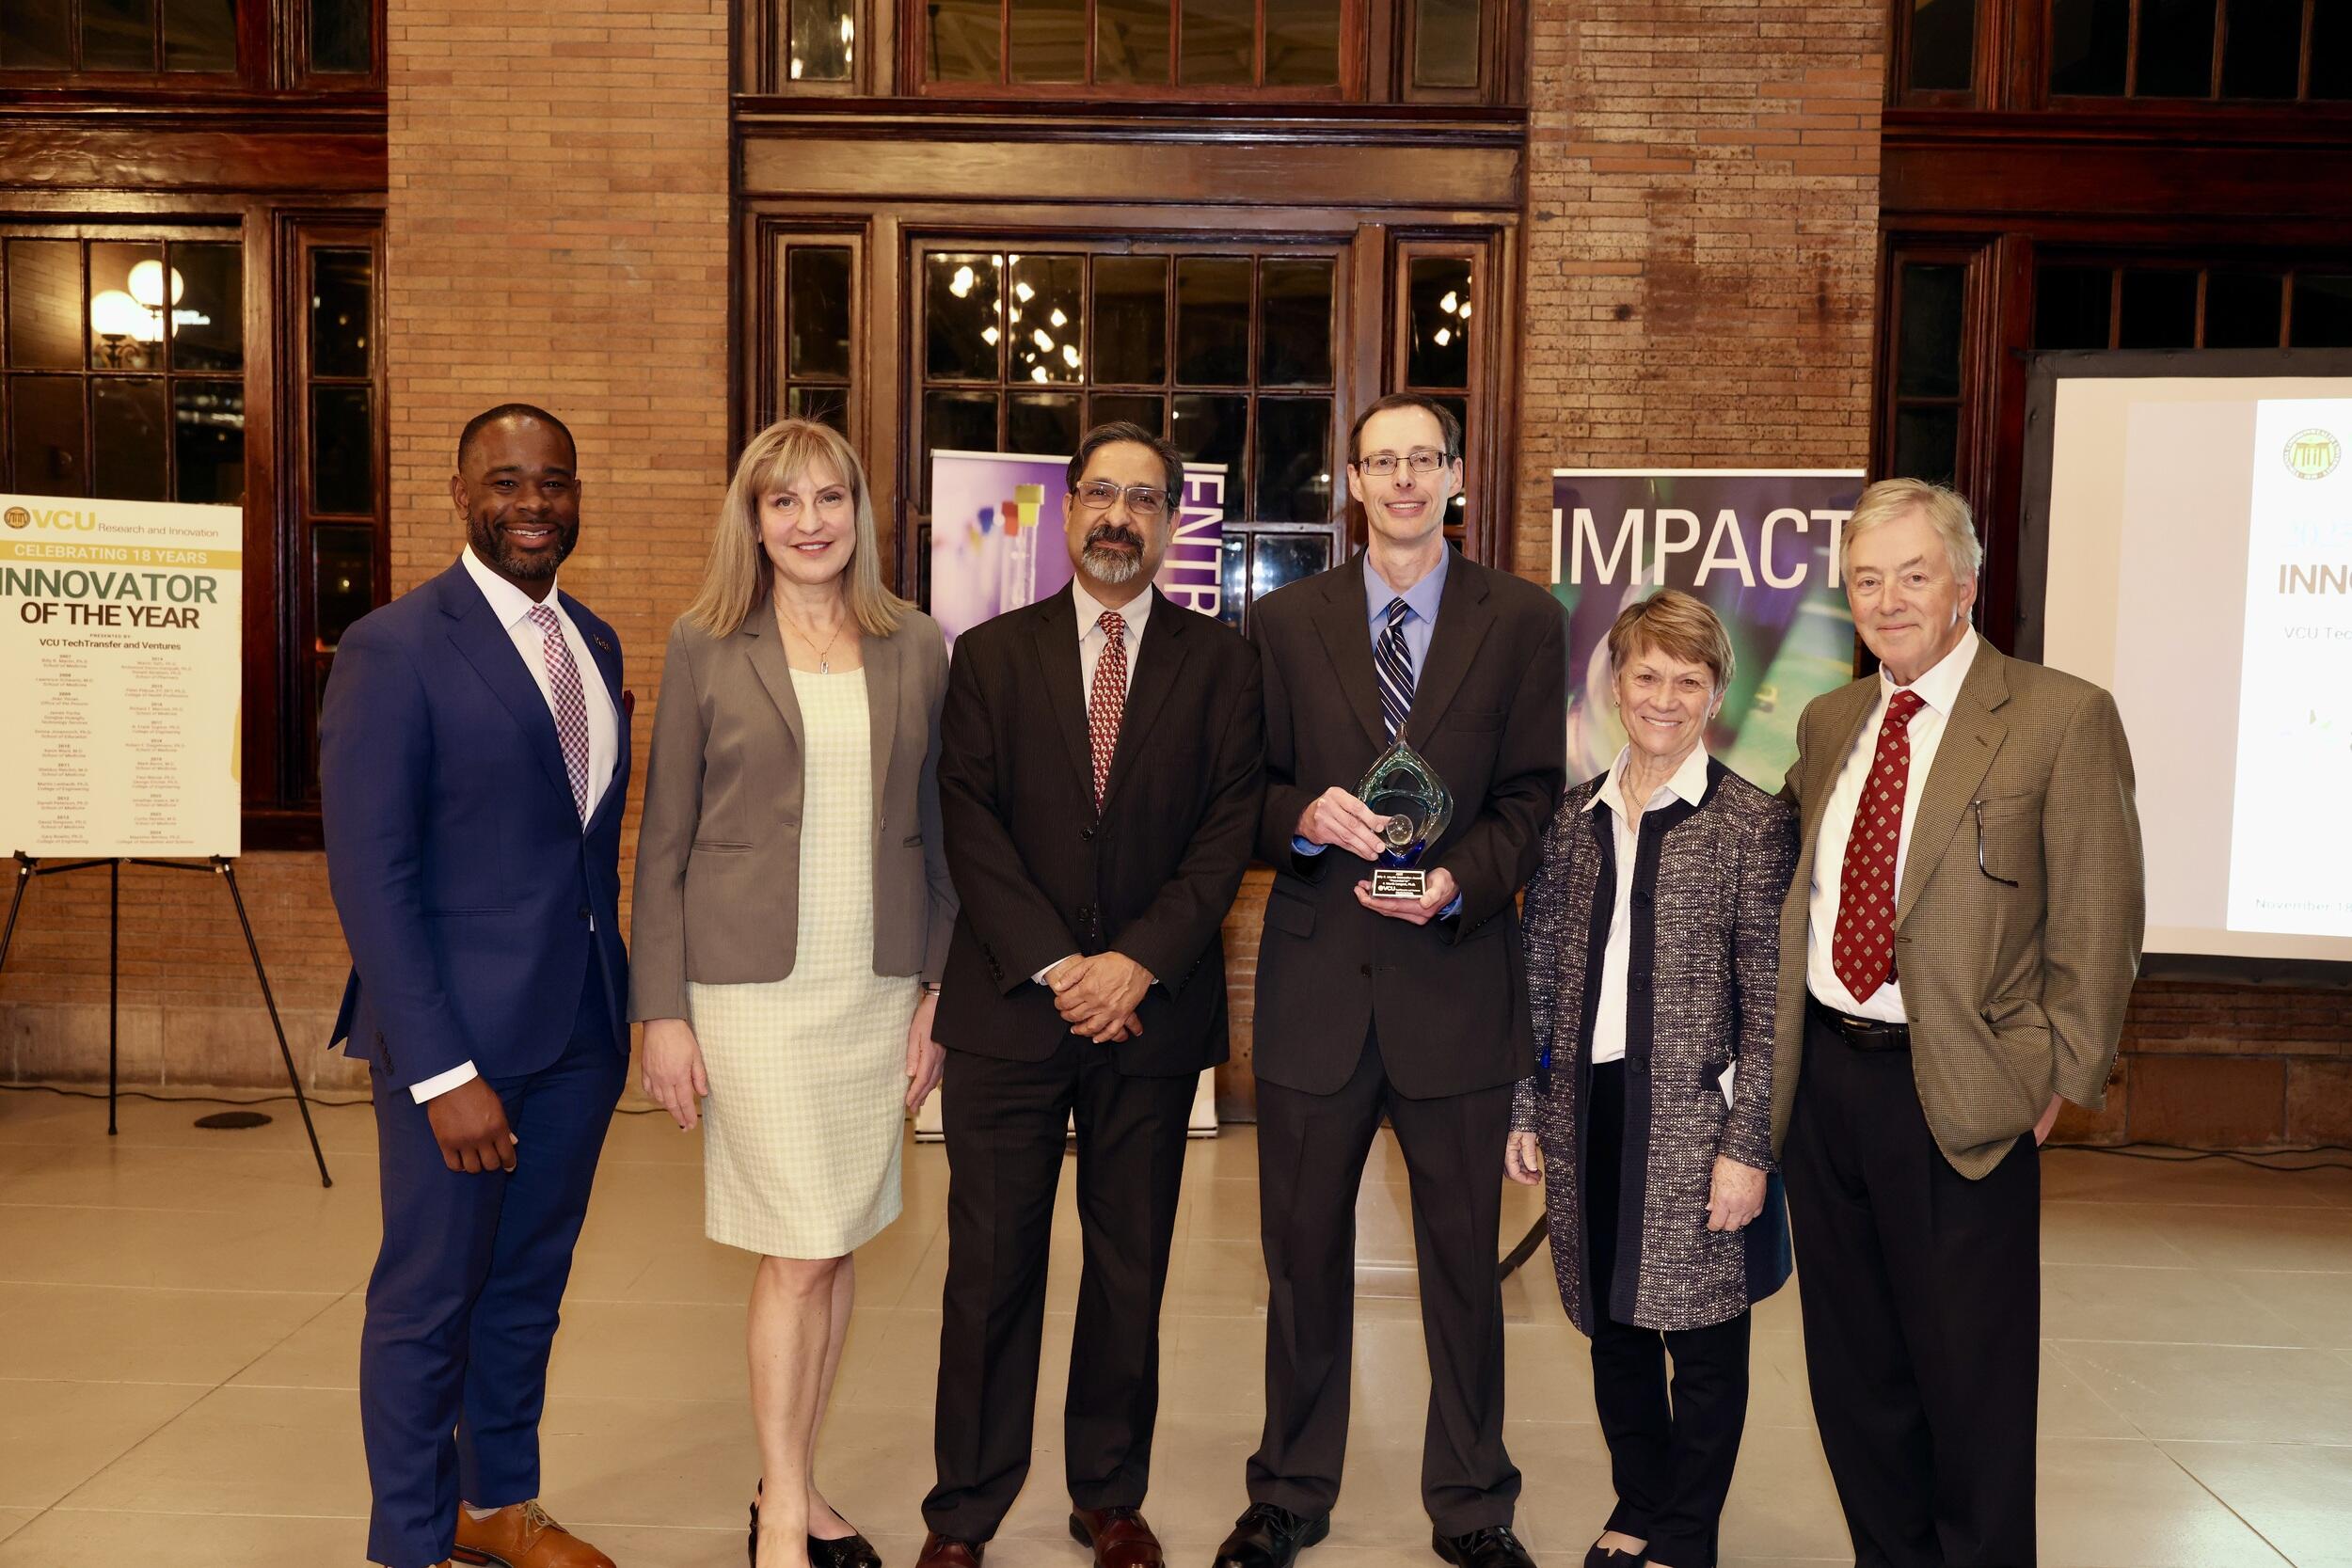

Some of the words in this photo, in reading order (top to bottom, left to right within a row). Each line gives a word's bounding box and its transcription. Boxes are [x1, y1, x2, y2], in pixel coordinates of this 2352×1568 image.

[32, 509, 96, 531] VCU
[98, 523, 145, 534] Research
[148, 526, 167, 535] and
[169, 526, 218, 537] Innovation
[14, 544, 128, 561] CELEBRATING
[133, 549, 151, 562] 18
[155, 549, 208, 564] YEARS
[1550, 507, 1854, 589] IMPACT
[2279, 563, 2352, 594] INN
[20, 602, 59, 624] OF
[64, 603, 121, 626] THE
[127, 606, 200, 629] YEAR
[40, 639, 59, 647] VCU
[62, 640, 121, 649] TechTransfer
[123, 641, 140, 649] and
[142, 641, 181, 650] Ventures
[2284, 626, 2319, 640] VCU
[2255, 898, 2330, 911] November
